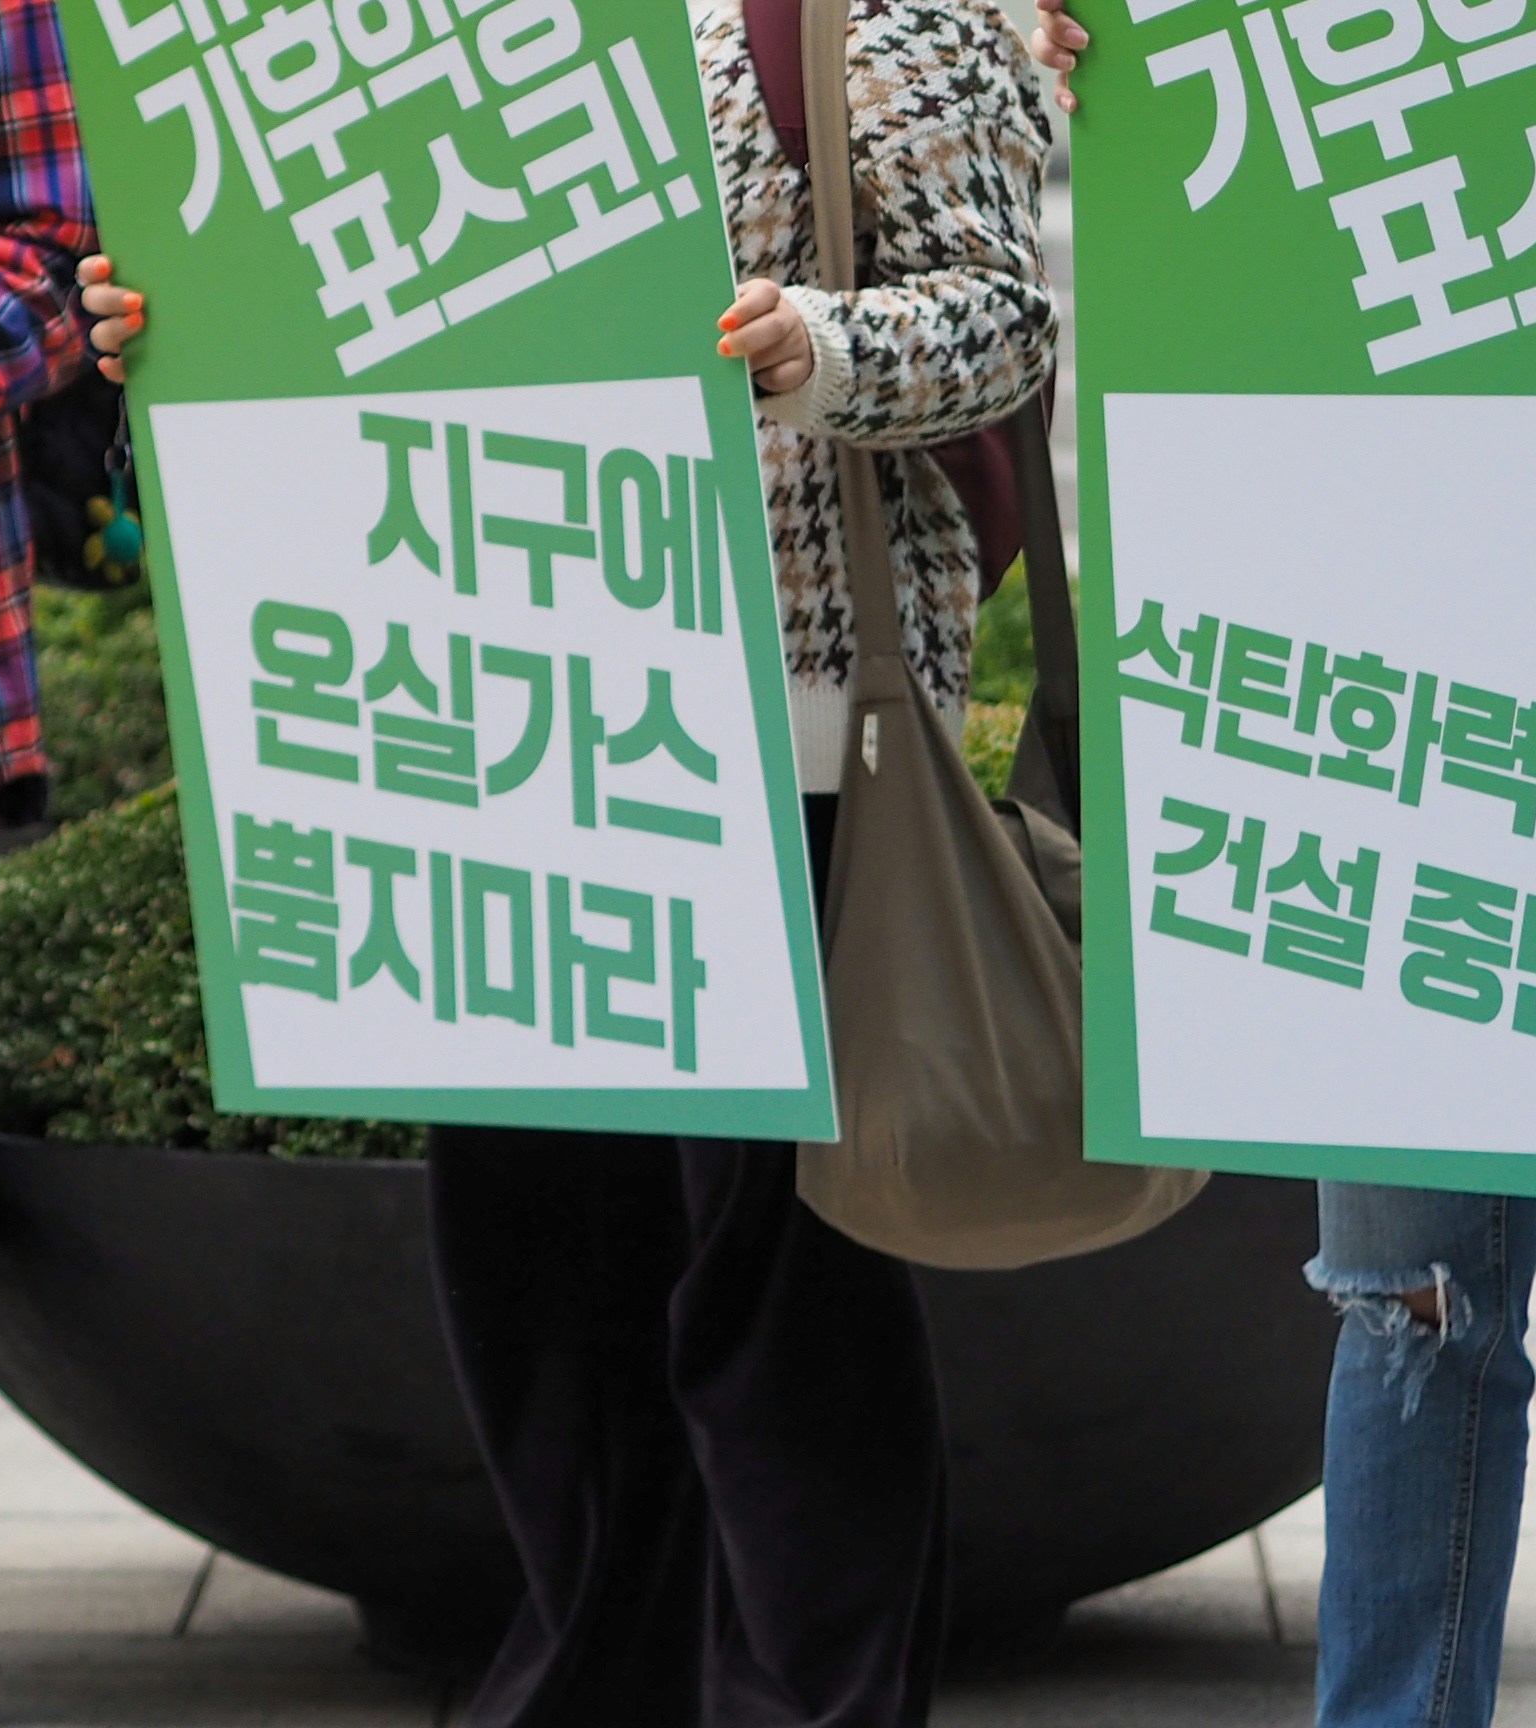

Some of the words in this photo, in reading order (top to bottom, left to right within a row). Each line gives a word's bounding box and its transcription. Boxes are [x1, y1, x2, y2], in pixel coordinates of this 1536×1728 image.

[289, 36, 702, 378] 포스코!
[358, 410, 723, 635] 지구에
[250, 599, 722, 846] 온실가스
[232, 811, 707, 1073] 뿜지마라
[1148, 796, 1381, 991] 건설
